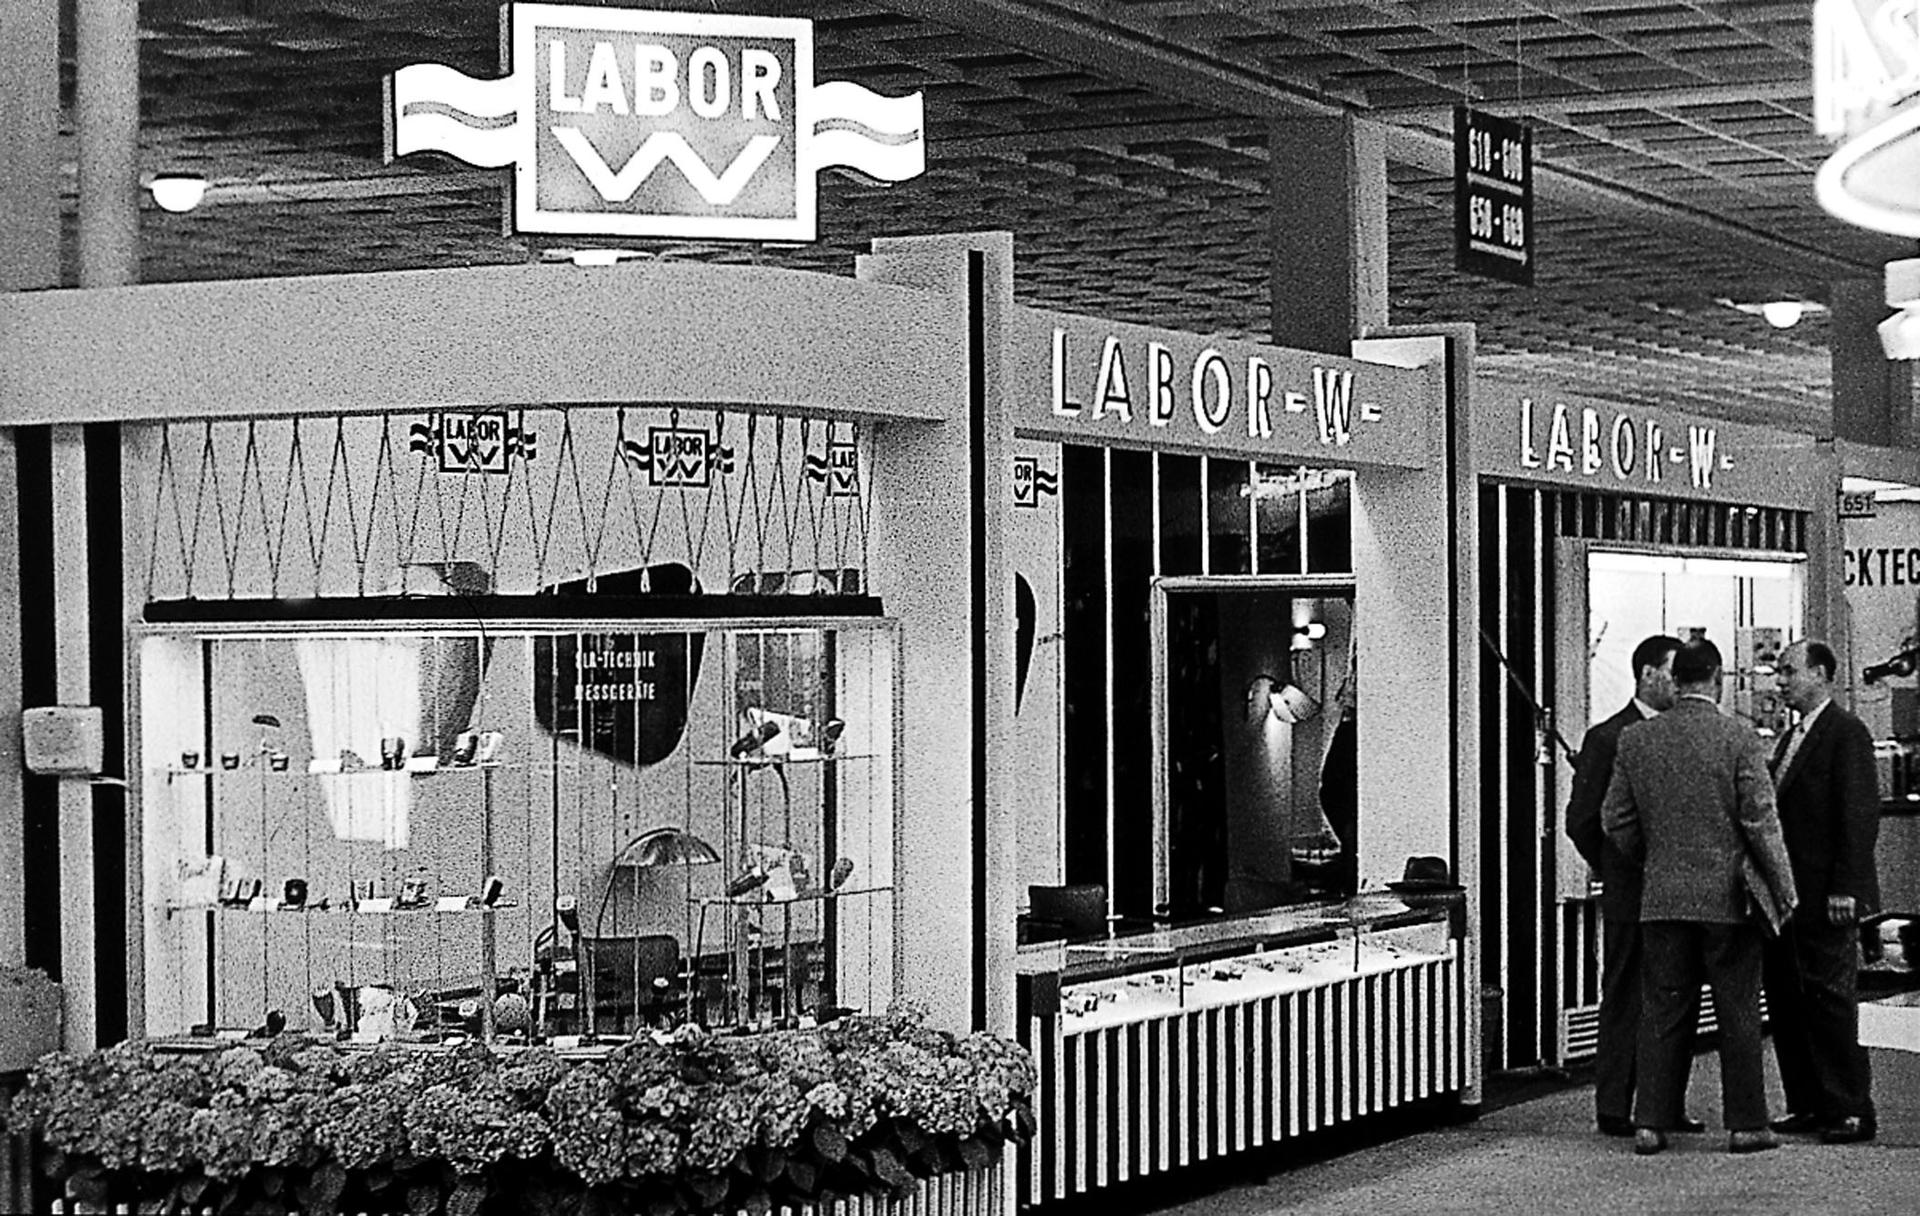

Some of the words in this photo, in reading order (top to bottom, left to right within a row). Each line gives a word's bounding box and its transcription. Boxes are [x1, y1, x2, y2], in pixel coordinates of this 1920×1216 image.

[549, 39, 782, 122] LABOR
[549, 125, 782, 205] W
[446, 417, 500, 441] LABOR
[654, 435, 703, 457] LABOR
